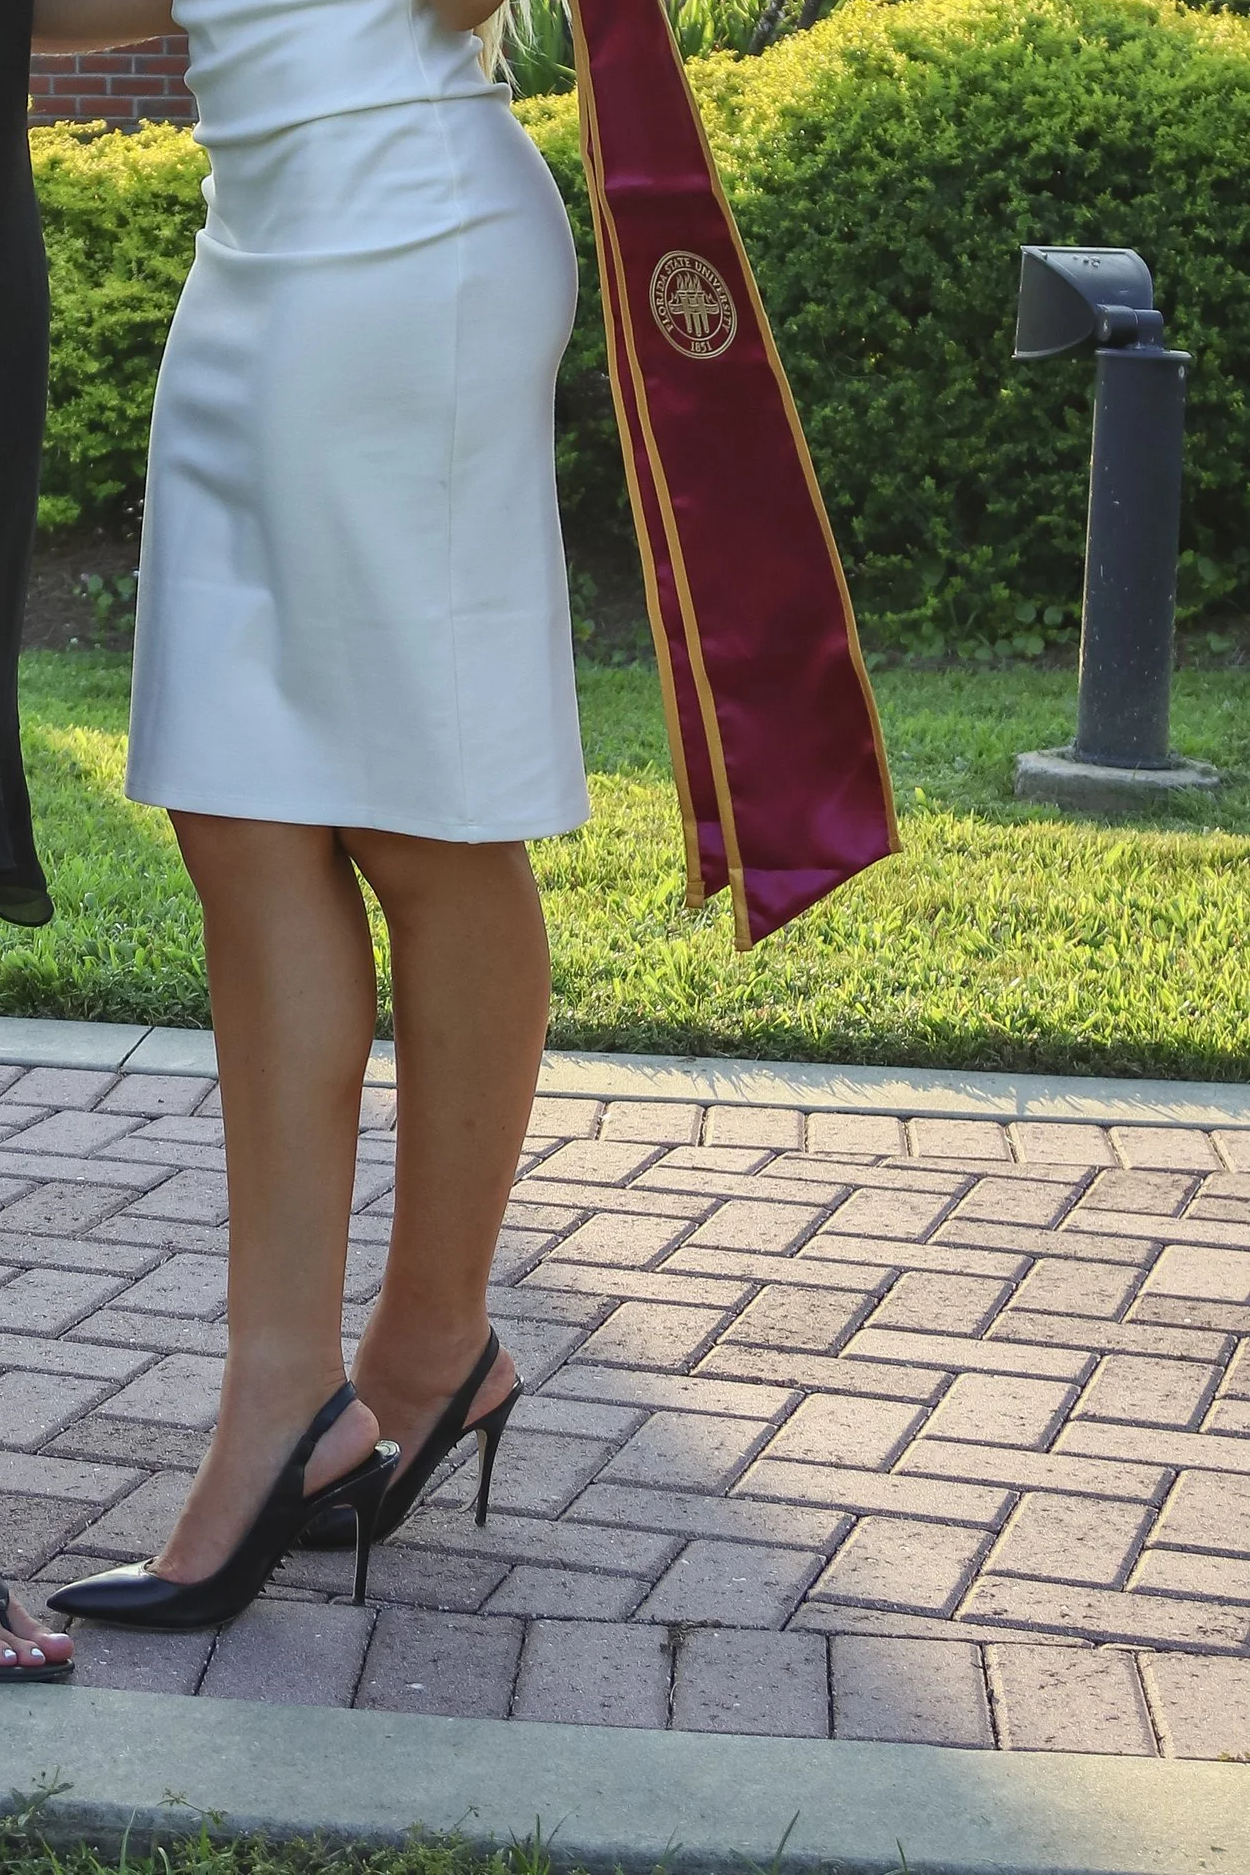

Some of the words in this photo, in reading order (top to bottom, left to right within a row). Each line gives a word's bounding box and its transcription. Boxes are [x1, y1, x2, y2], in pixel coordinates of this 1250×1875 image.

[664, 257, 691, 274] STATE
[655, 274, 674, 333] FLORIDA
[695, 261, 731, 333] UNIVERSITY
[690, 341, 712, 353] 1851
